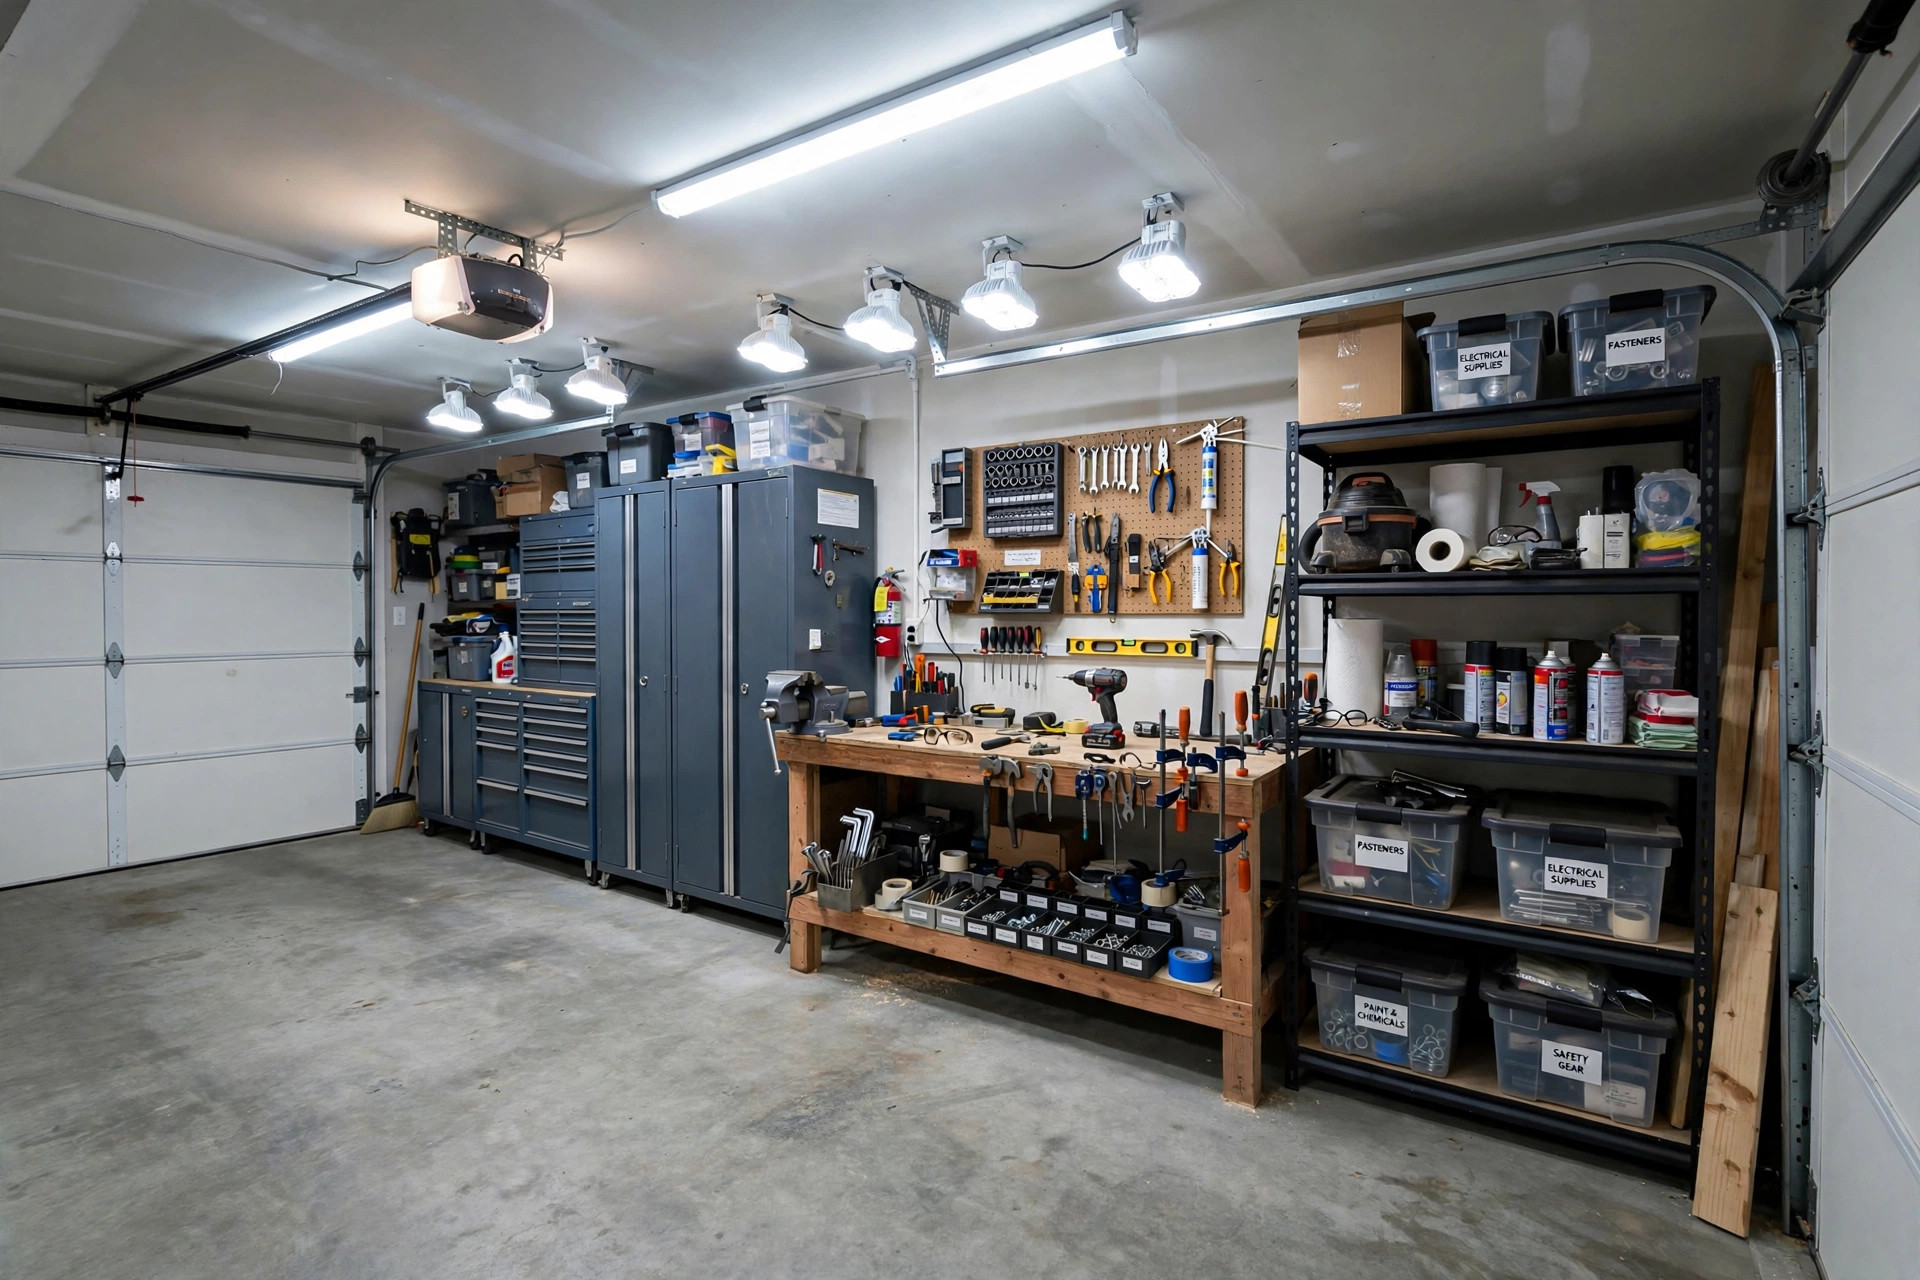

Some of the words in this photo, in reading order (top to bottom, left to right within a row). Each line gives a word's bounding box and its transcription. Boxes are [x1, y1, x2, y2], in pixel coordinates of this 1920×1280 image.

[1608, 336, 1662, 349] FASTENERS
[1460, 350, 1509, 362] ELECTRICAL
[1464, 361, 1503, 372] SUPPLIES
[1548, 864, 1605, 878] ELECTRICAL
[1551, 875, 1596, 888] SUPPLIES
[1364, 1002, 1388, 1015] PAINT
[1357, 1012, 1406, 1028] CHEMICALS
[1553, 1048, 1589, 1064] SAFETY
[1558, 1062, 1584, 1074] GEAR
